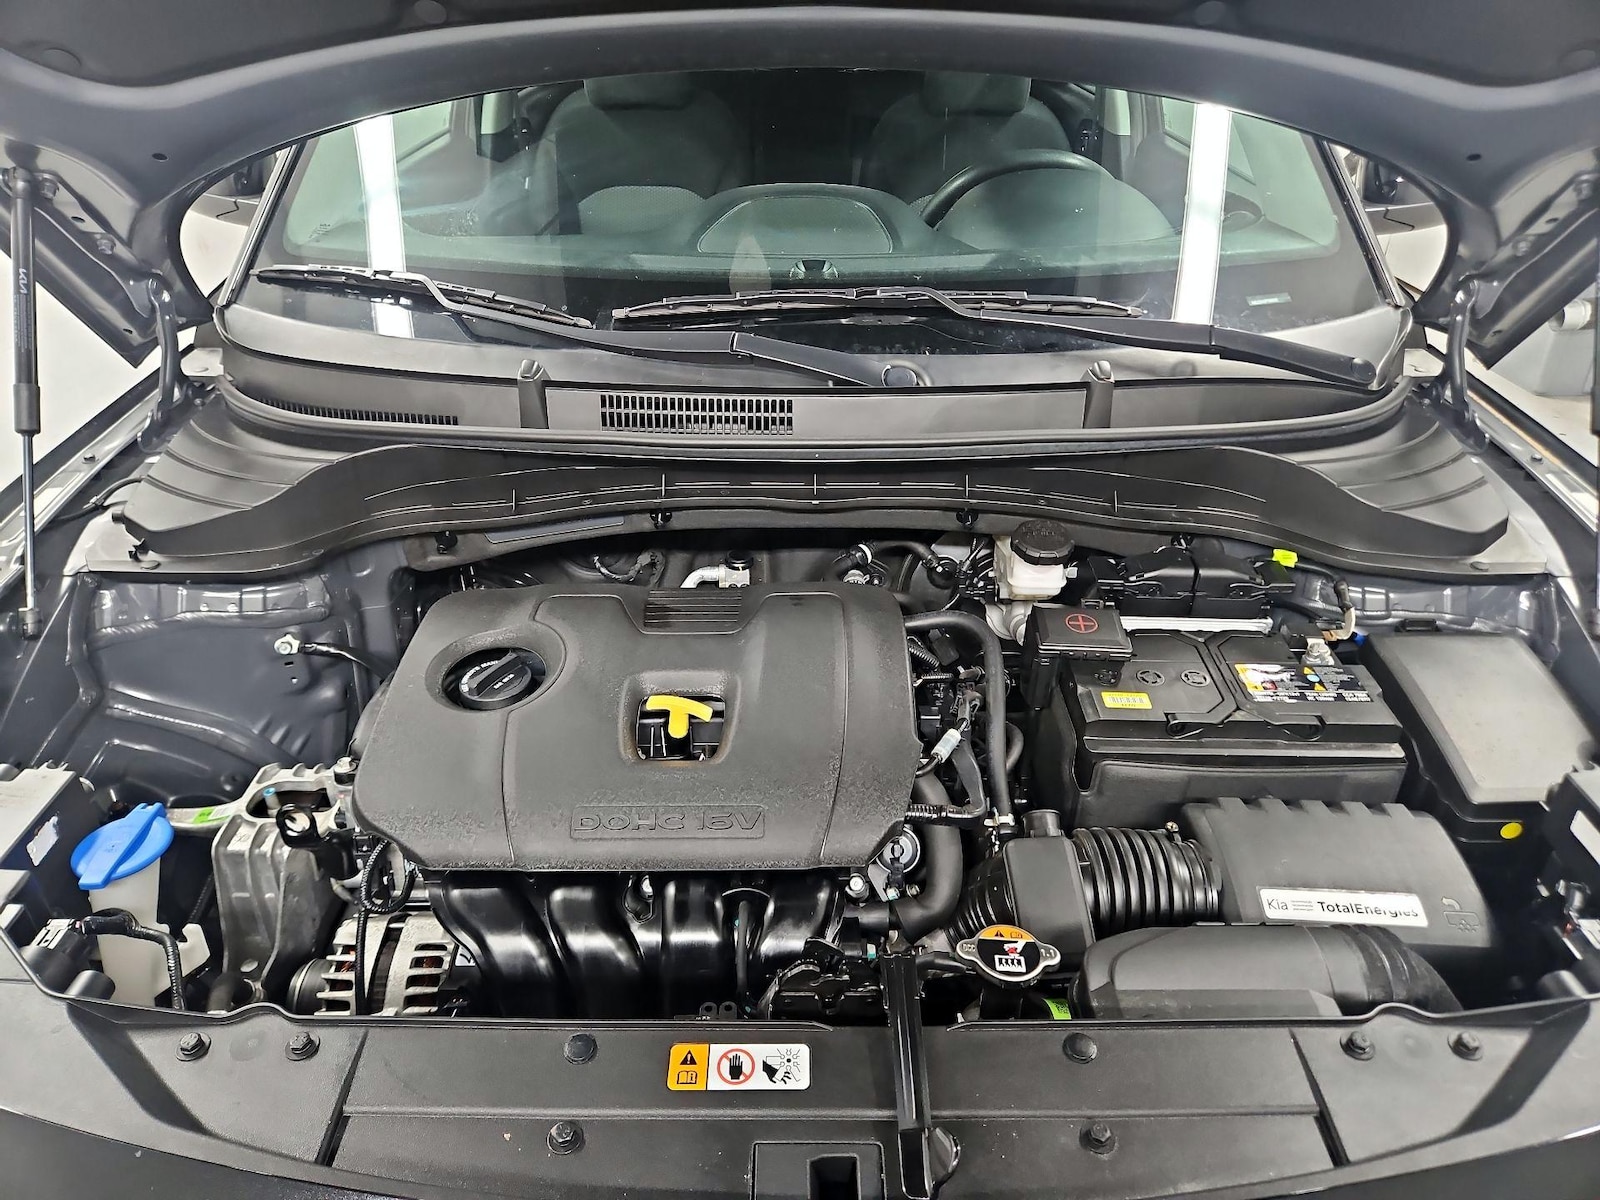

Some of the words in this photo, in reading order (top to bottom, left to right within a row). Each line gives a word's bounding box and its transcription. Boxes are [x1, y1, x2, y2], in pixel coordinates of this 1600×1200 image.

[573, 812, 686, 831] DOHC
[697, 811, 762, 831] 16V
[1266, 897, 1289, 911] Kia
[1040, 948, 1055, 958] 1.1
